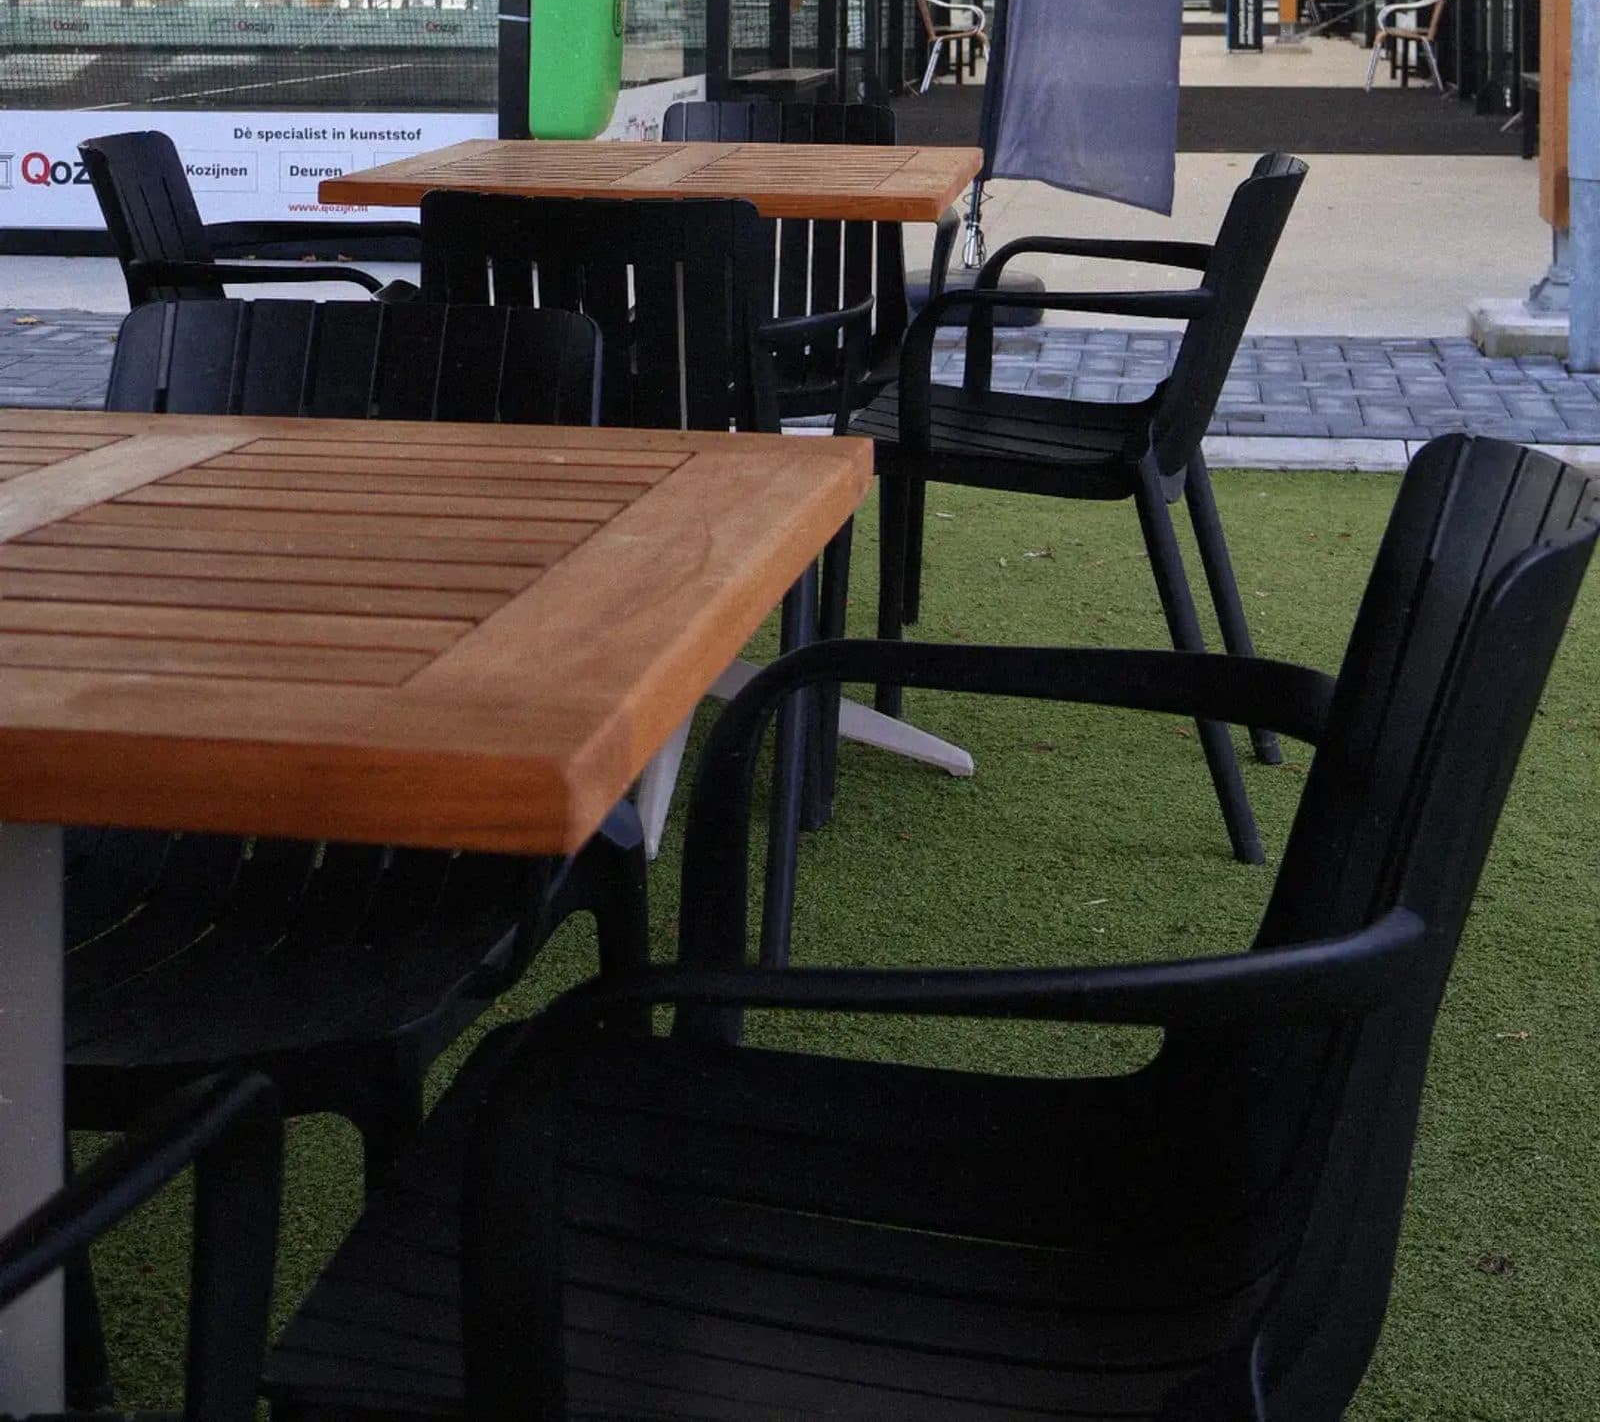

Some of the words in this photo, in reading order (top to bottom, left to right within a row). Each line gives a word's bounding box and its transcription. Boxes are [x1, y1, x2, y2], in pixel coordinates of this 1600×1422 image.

[257, 127, 328, 142] specialist
[332, 128, 345, 140] in
[350, 128, 422, 140] kunststof
[21, 152, 92, 186] Qoz
[185, 163, 248, 179] Kozijnen
[289, 165, 343, 177] Deuren
